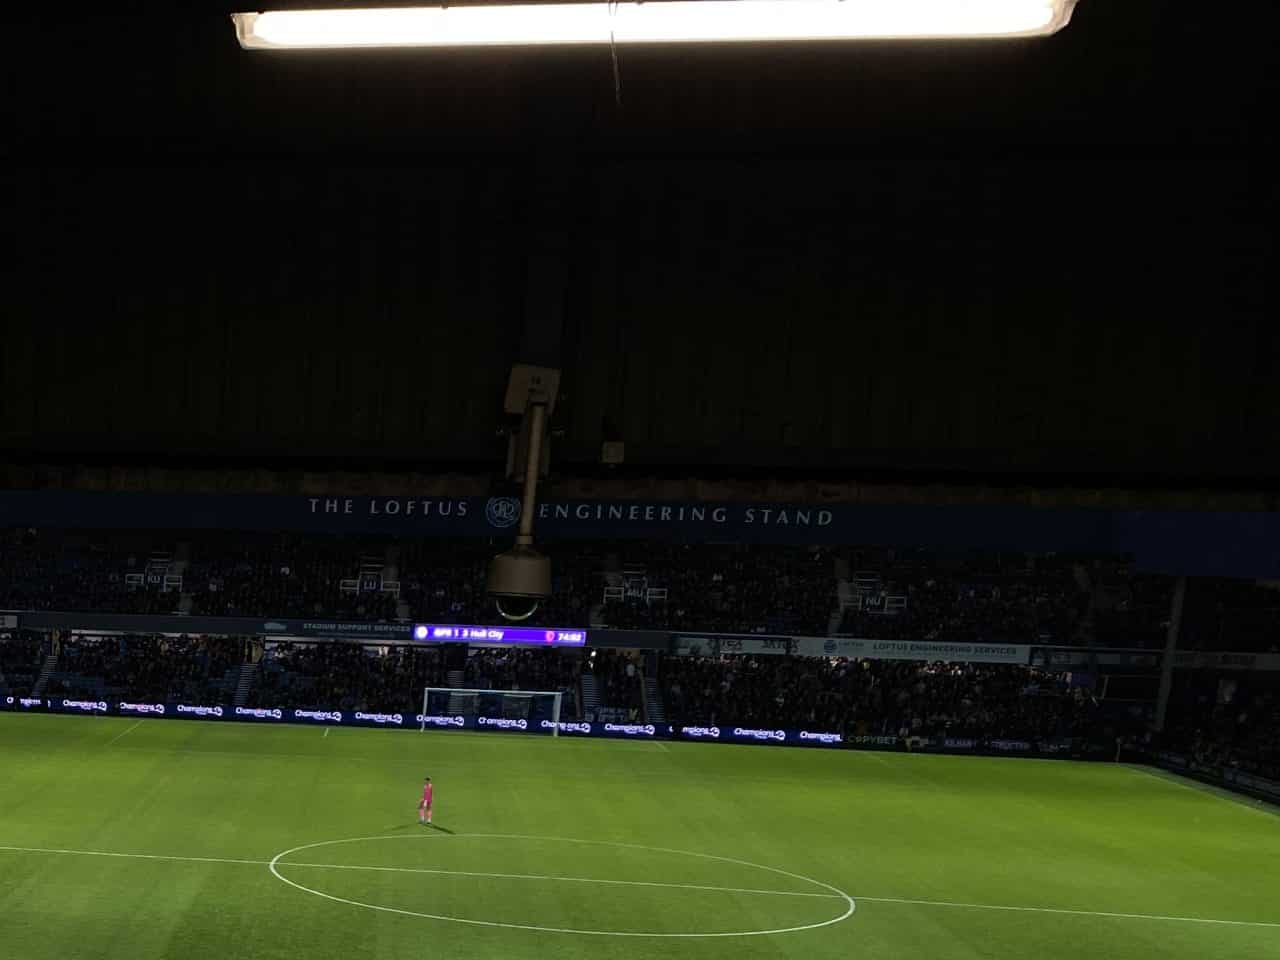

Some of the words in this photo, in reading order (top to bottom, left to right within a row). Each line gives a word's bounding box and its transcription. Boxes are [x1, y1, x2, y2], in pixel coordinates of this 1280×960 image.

[308, 498, 353, 514] THE
[369, 499, 468, 517] LOFTUS
[539, 503, 728, 524] ENGINEERING
[744, 508, 834, 527] STAND
[470, 629, 487, 639] Hull
[488, 629, 504, 641] City
